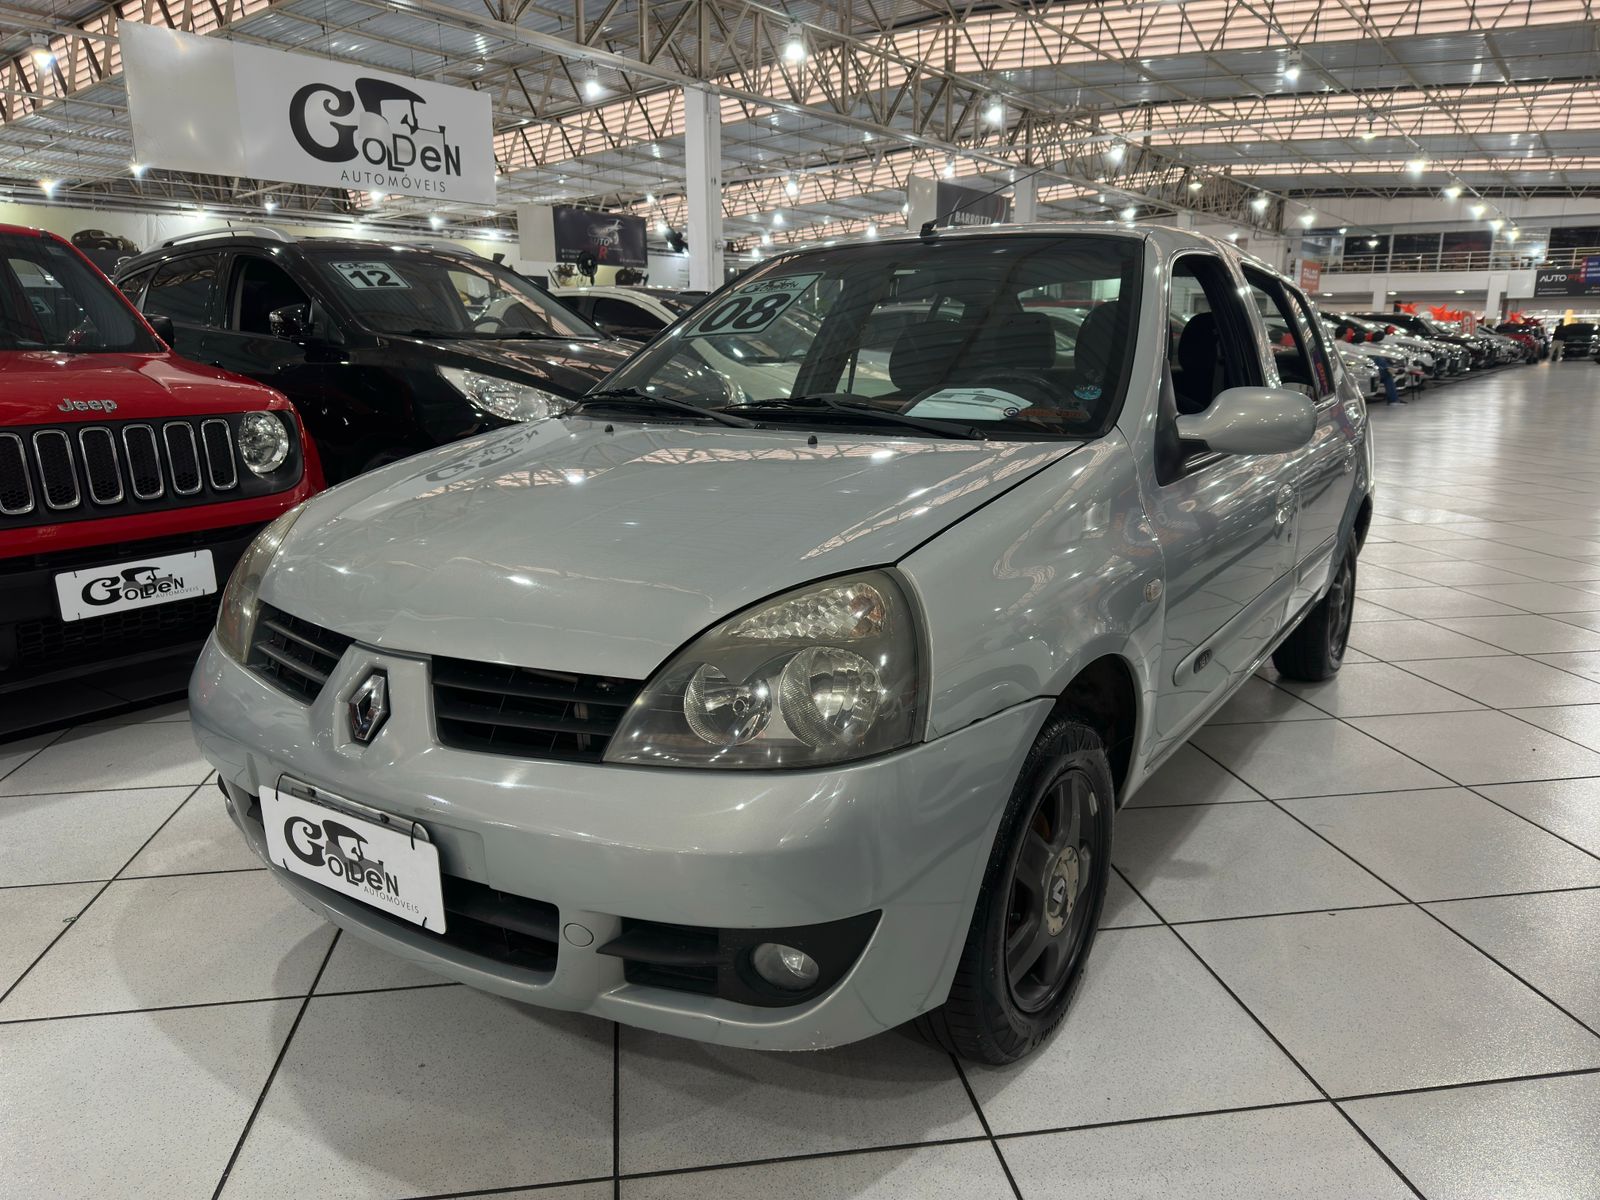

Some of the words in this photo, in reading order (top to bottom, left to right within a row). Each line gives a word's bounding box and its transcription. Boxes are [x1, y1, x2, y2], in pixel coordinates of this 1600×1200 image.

[340, 169, 446, 193] AUTOMÓVEIS
[348, 270, 401, 287] 12
[1540, 274, 1567, 282] AUTO
[698, 292, 792, 333] 08
[57, 398, 118, 413] Jeep
[363, 886, 420, 914] AUTOMÓVEIS
